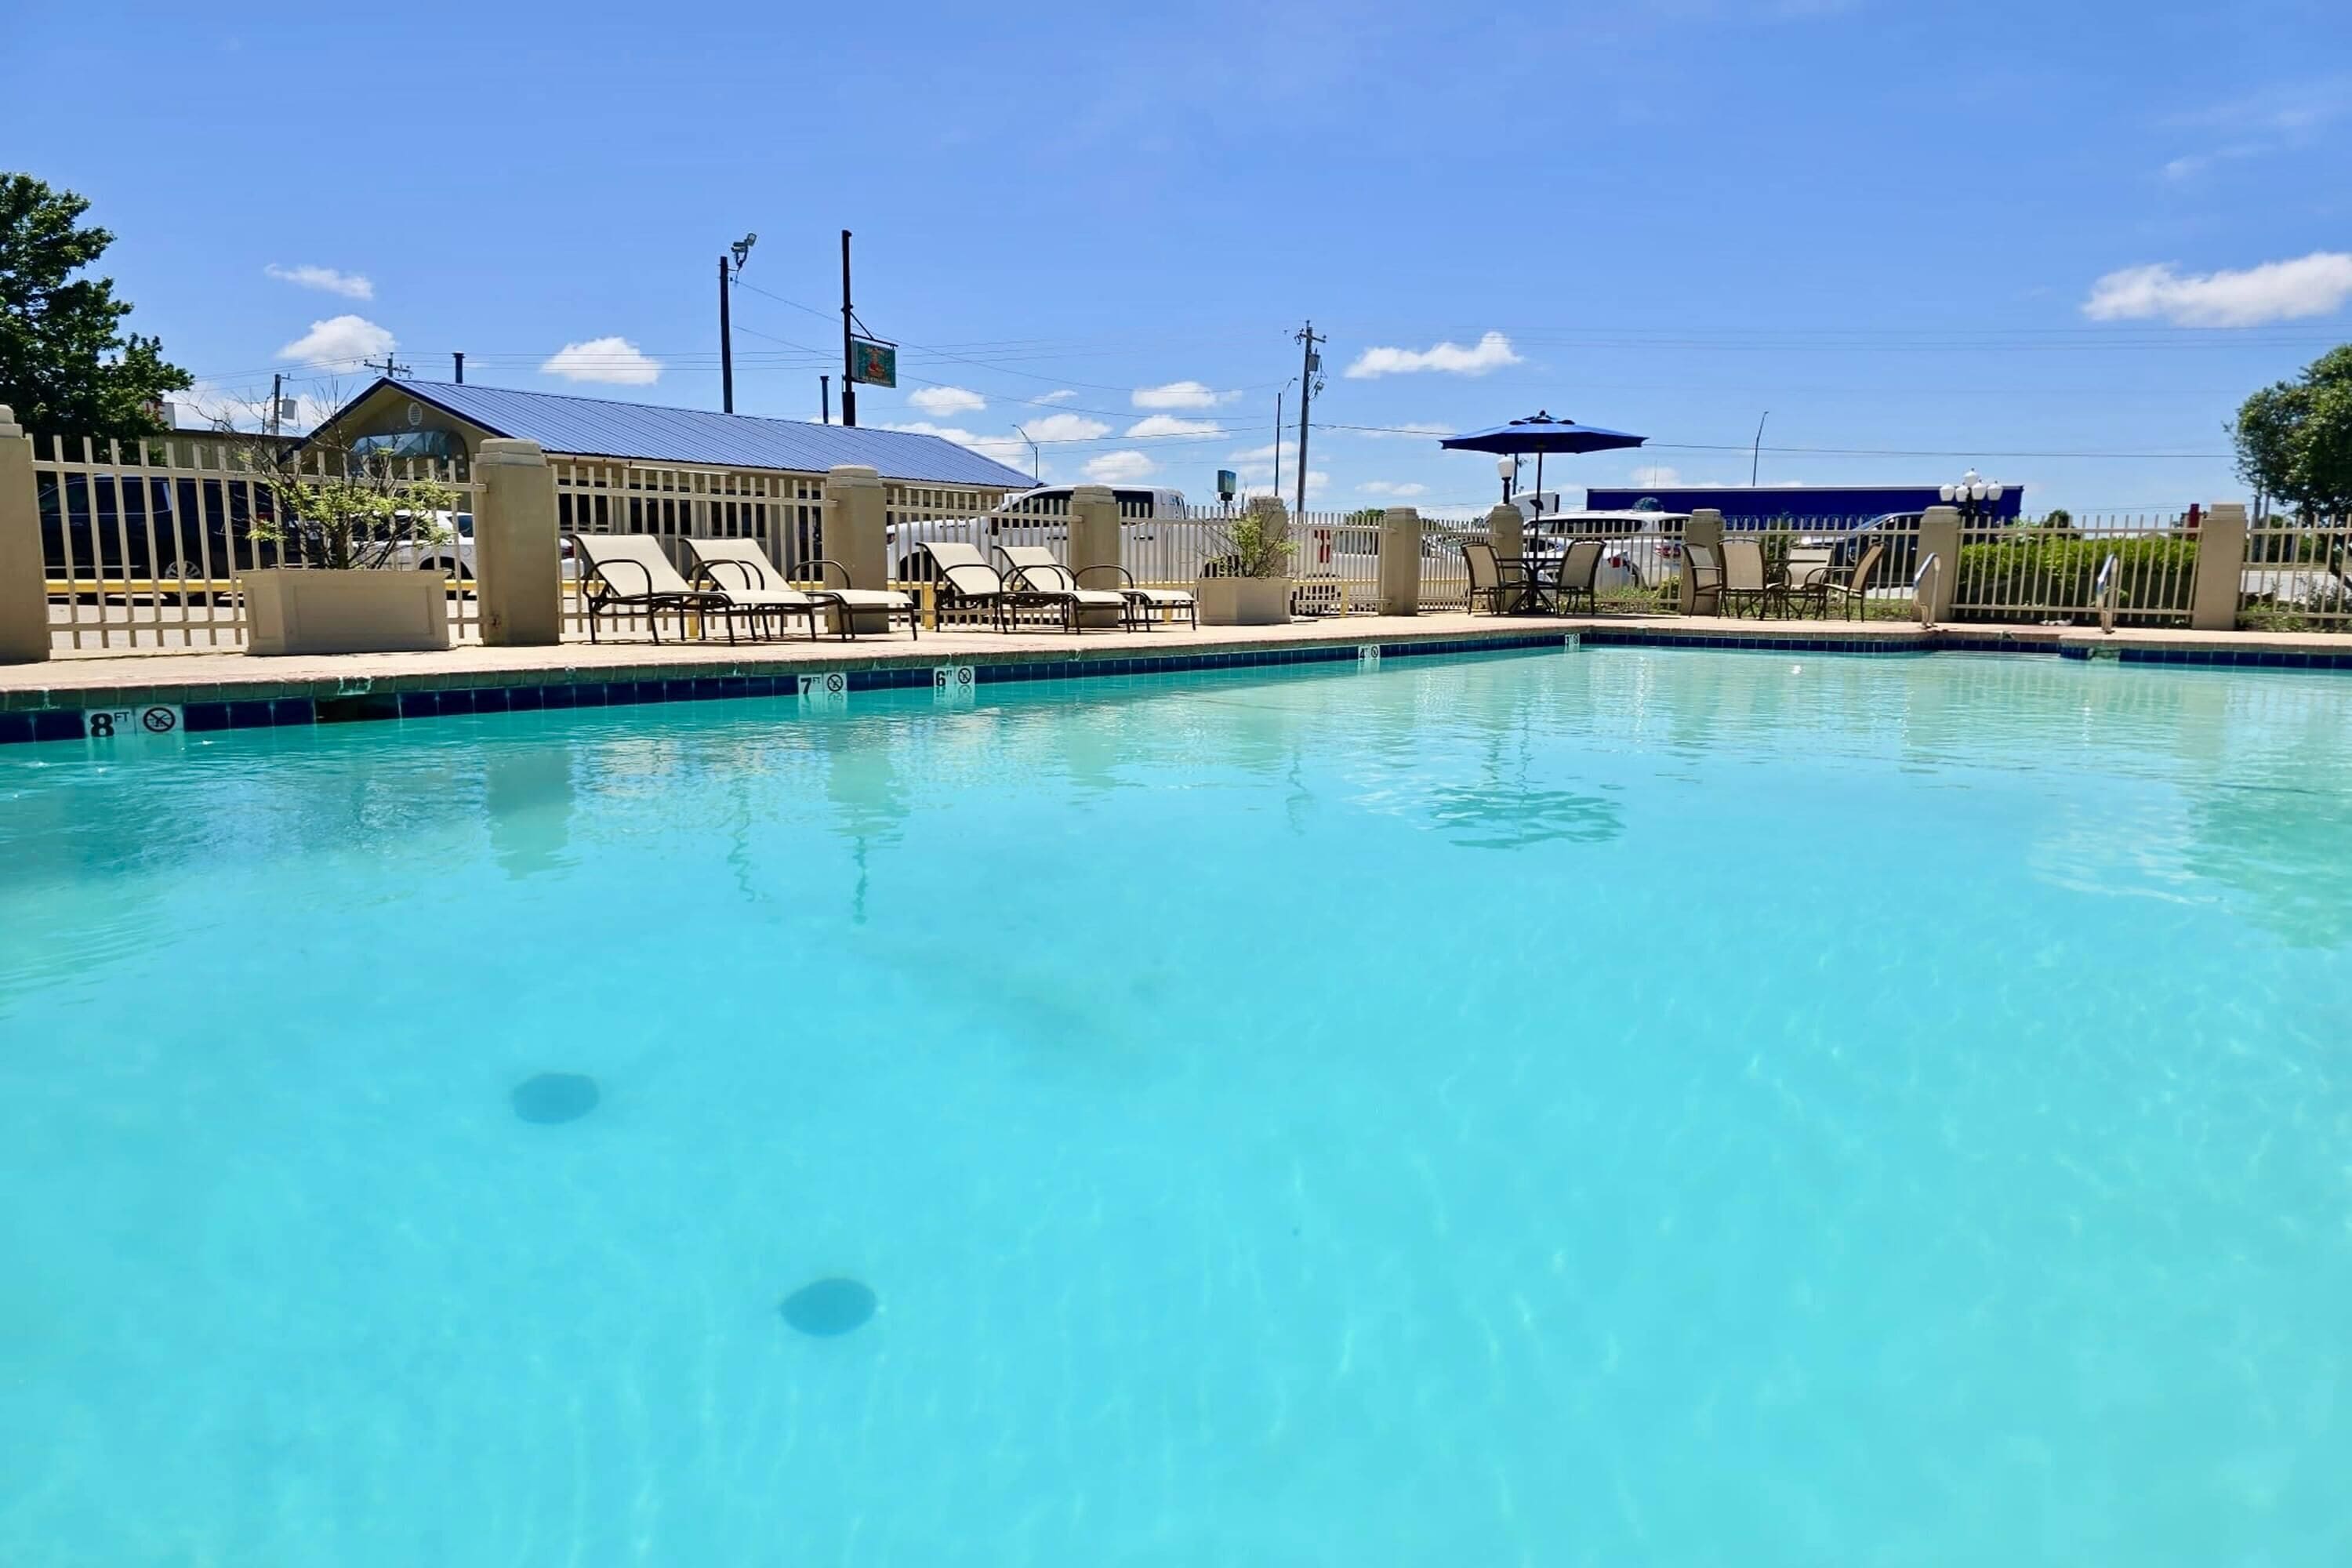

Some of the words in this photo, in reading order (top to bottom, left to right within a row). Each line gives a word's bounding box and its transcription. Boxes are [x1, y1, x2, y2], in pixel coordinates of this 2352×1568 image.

[1720, 514, 1758, 528] EW
[800, 677, 812, 695] 7
[936, 670, 946, 687] 6
[90, 713, 114, 737] 8
[114, 711, 129, 722] FT
